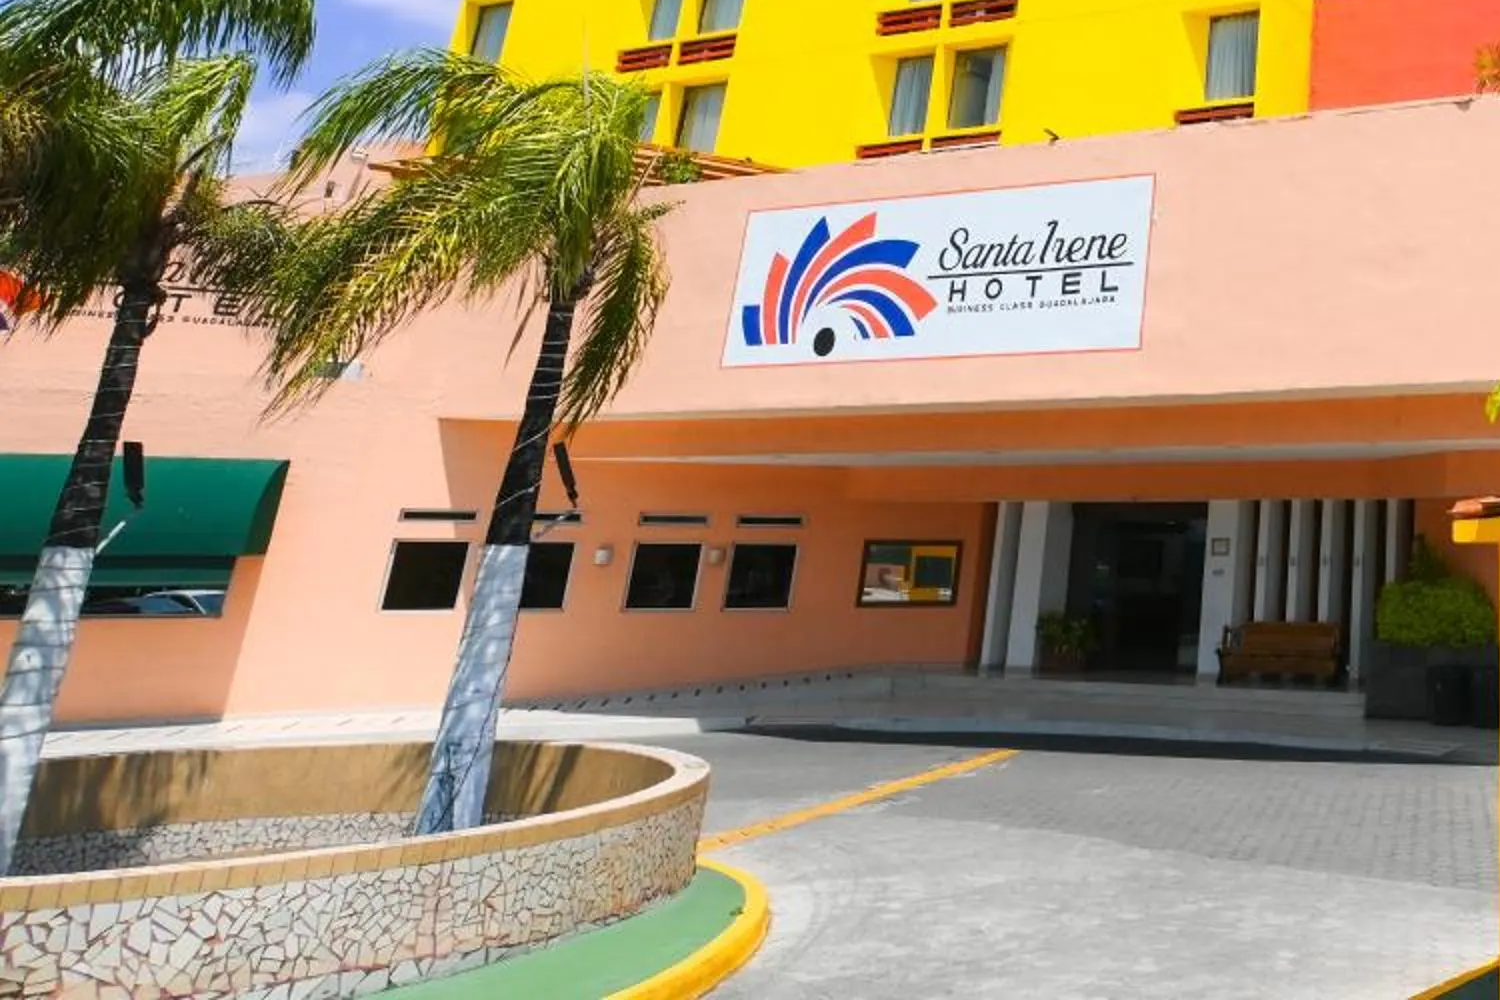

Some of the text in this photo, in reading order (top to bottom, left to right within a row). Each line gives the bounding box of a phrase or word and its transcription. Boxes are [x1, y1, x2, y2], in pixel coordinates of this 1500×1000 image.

[938, 219, 1129, 271] Santa Irene
[948, 270, 1119, 302] HOTEL
